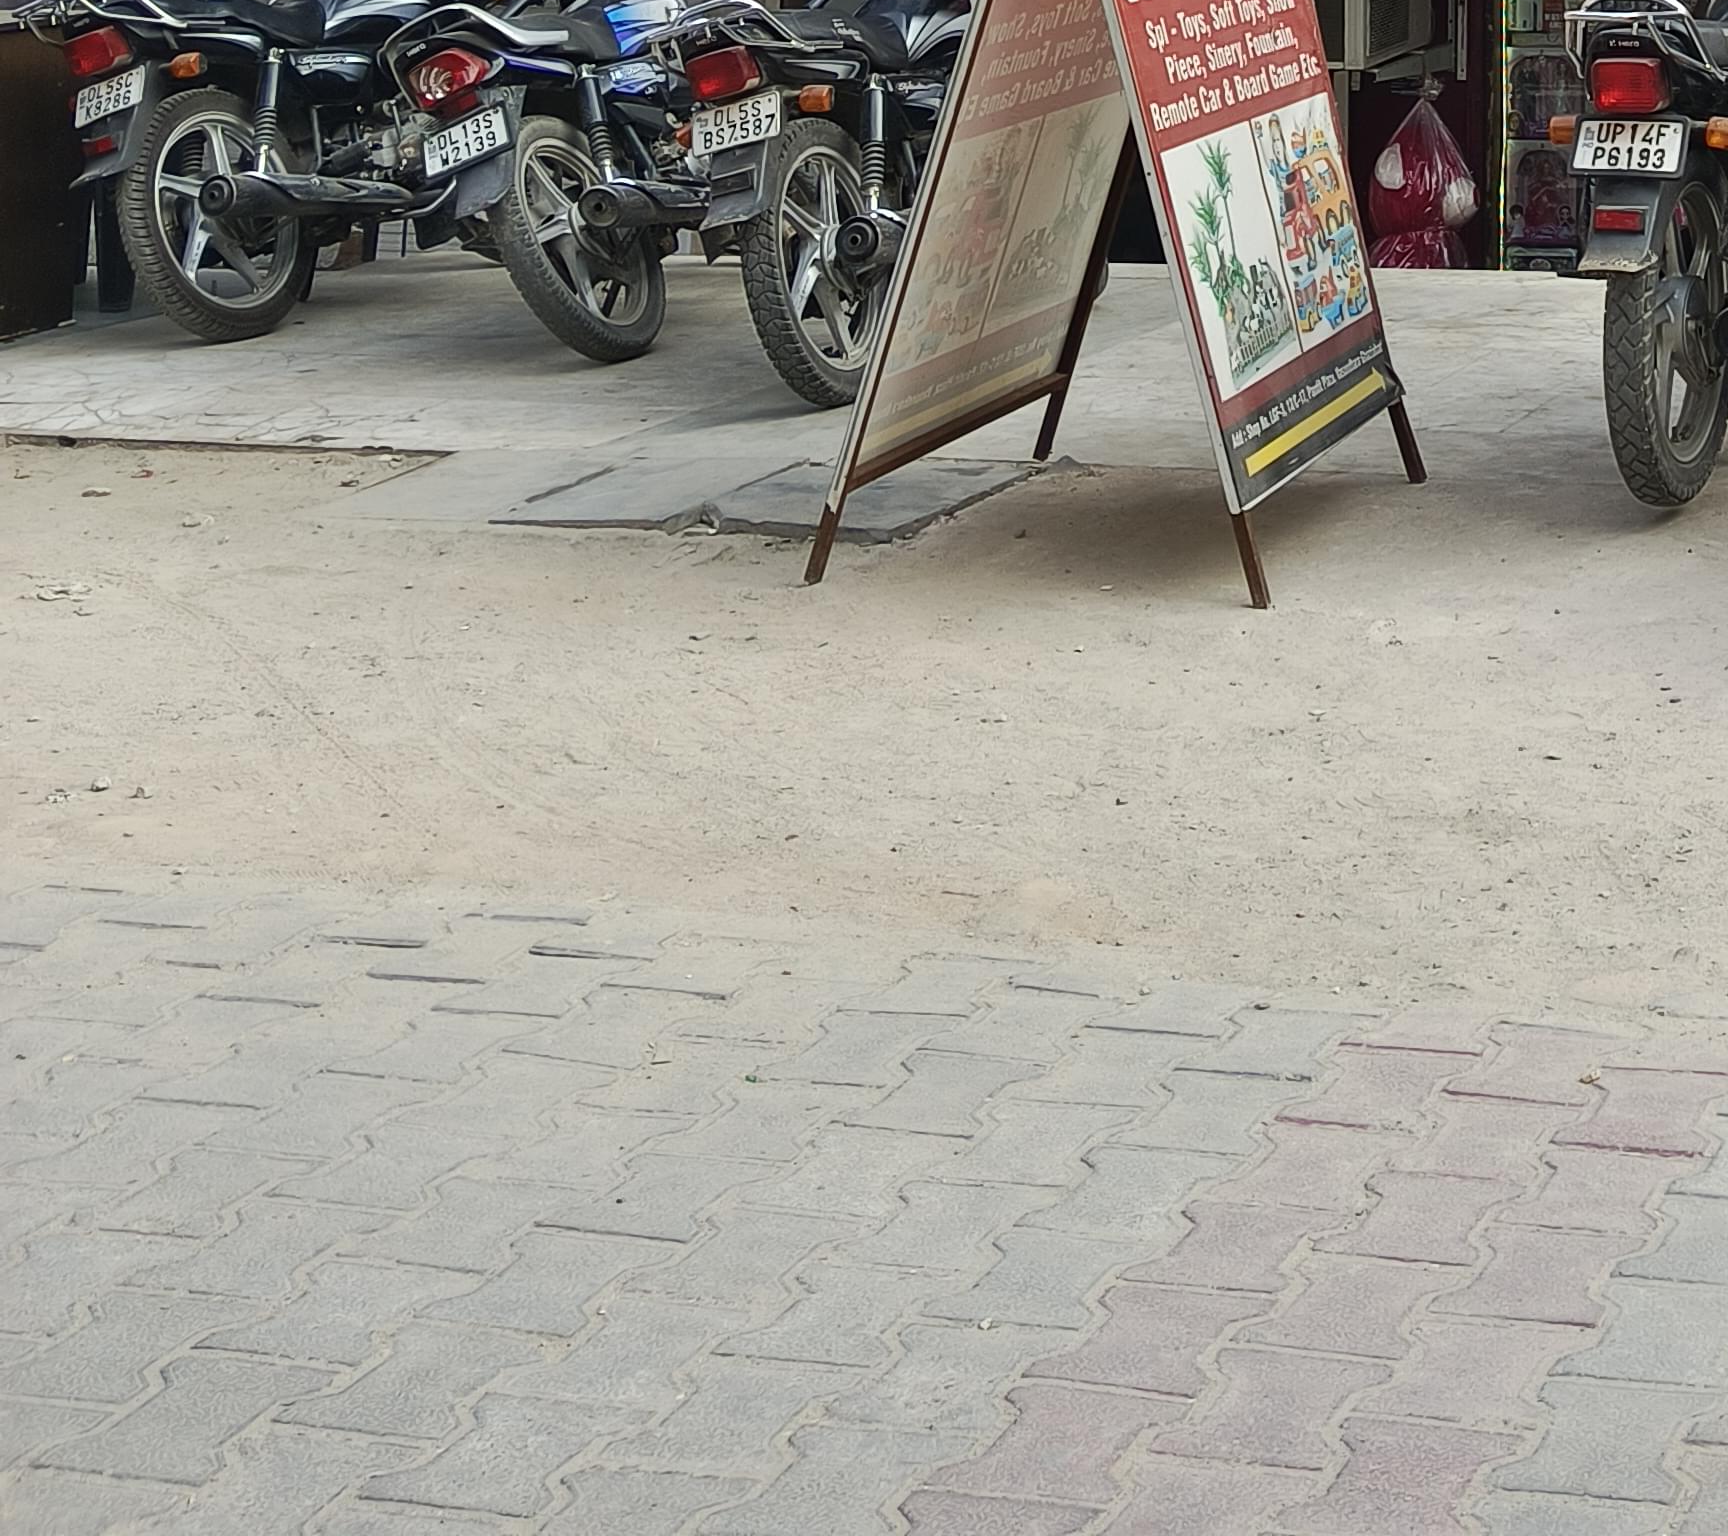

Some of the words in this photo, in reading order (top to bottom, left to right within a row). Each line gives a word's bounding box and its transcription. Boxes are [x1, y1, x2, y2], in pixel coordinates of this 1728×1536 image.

[88, 73, 133, 102] DL5SC
[714, 101, 761, 127] DL5S
[1150, 93, 1200, 132] Remote
[437, 114, 492, 150] DL13S
[704, 113, 775, 149] BS7587
[1597, 123, 1670, 145] UP14F
[440, 131, 496, 167] W2139
[1592, 147, 1665, 169] P6193
